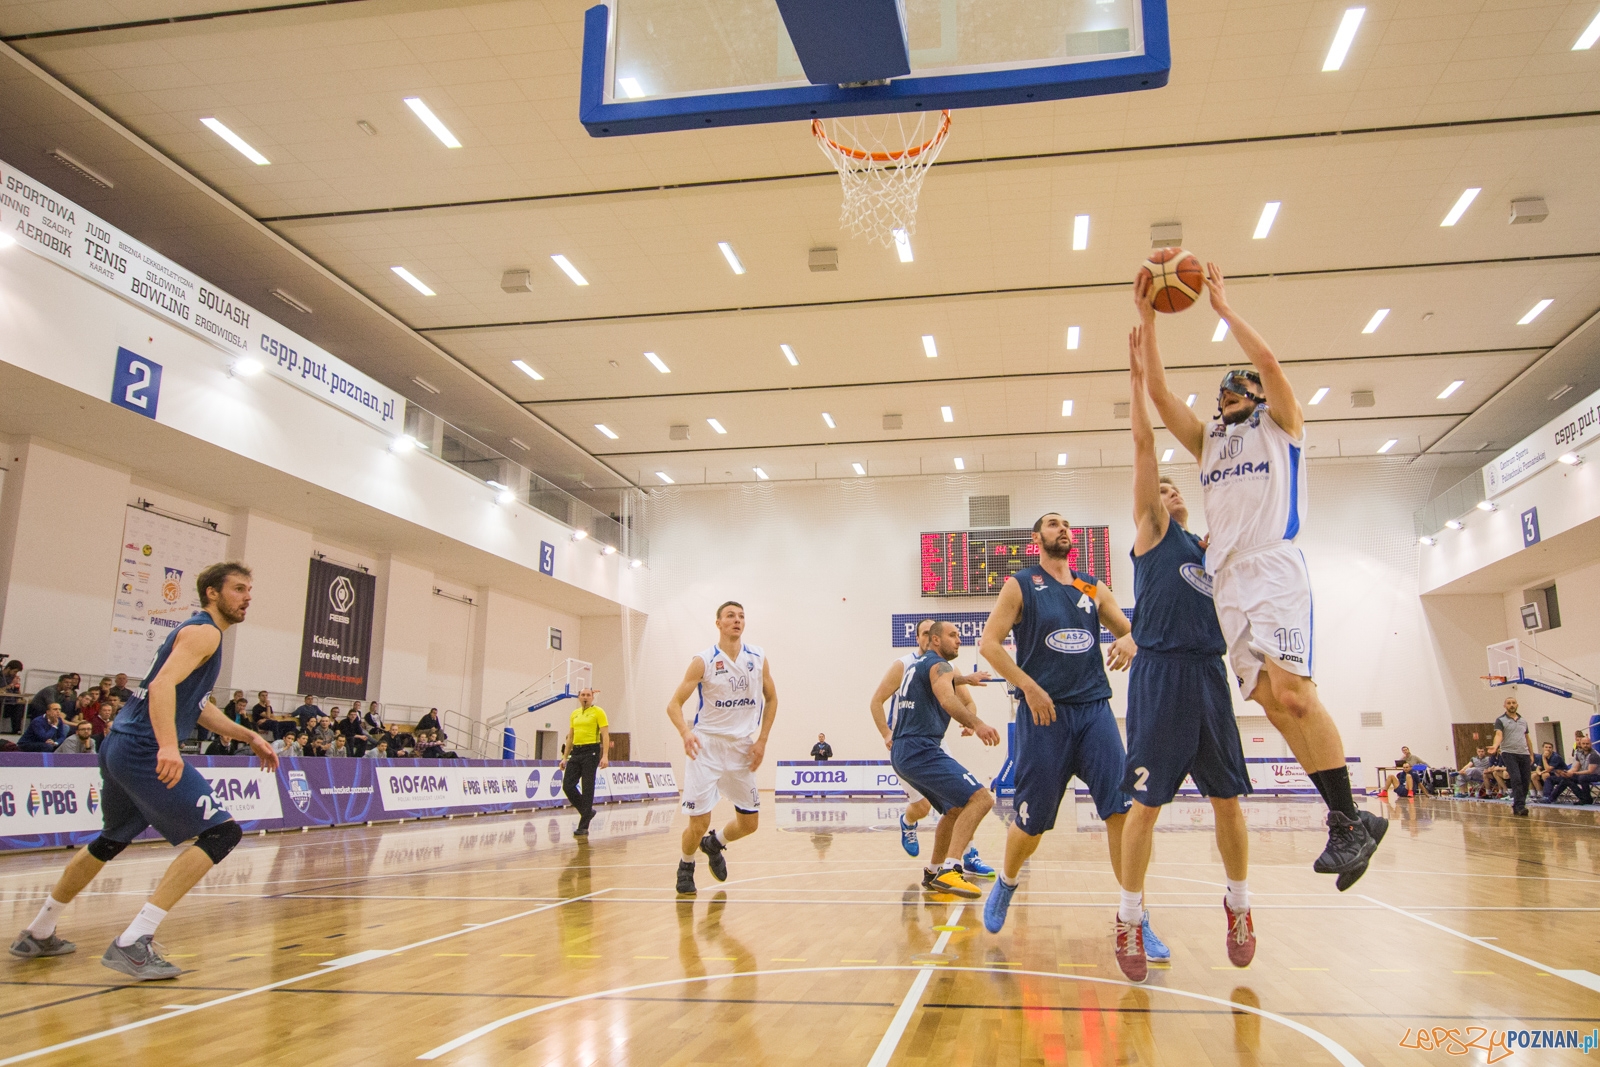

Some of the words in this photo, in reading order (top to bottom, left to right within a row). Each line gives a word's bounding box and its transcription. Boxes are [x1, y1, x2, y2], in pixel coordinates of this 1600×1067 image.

[6, 176, 76, 225] SPORTOWA
[16, 219, 72, 258] AEROBIK
[42, 216, 73, 239] SZACHY
[85, 222, 111, 244] JUDO
[84, 237, 127, 274] TENIS
[89, 261, 115, 280] KARATE
[142, 255, 194, 289] LEKKOATLETYCZNA
[146, 270, 186, 300] SIŁOWNIA
[131, 277, 190, 321] BOWLING
[198, 286, 250, 329] SQUASH
[125, 360, 151, 409] 2
[260, 333, 394, 422] cspp.put.poznan.pl
[1524, 512, 1535, 542] 3
[543, 545, 552, 571] 3
[1076, 594, 1093, 614] 4
[1274, 627, 1305, 654] 10
[311, 648, 330, 660] które
[331, 652, 342, 663] się
[342, 655, 360, 665] czyta
[729, 675, 748, 692] 14
[39, 782, 75, 790] fundacja
[389, 775, 449, 794] BIOFARM
[467, 780, 481, 795] PBG
[487, 780, 500, 794] PBG
[506, 779, 518, 793] PBG
[612, 772, 640, 785] BIOFARM
[652, 774, 676, 787] NICKEL
[1133, 766, 1149, 792] 2
[41, 790, 78, 815] PBG
[1019, 800, 1030, 826] 4
